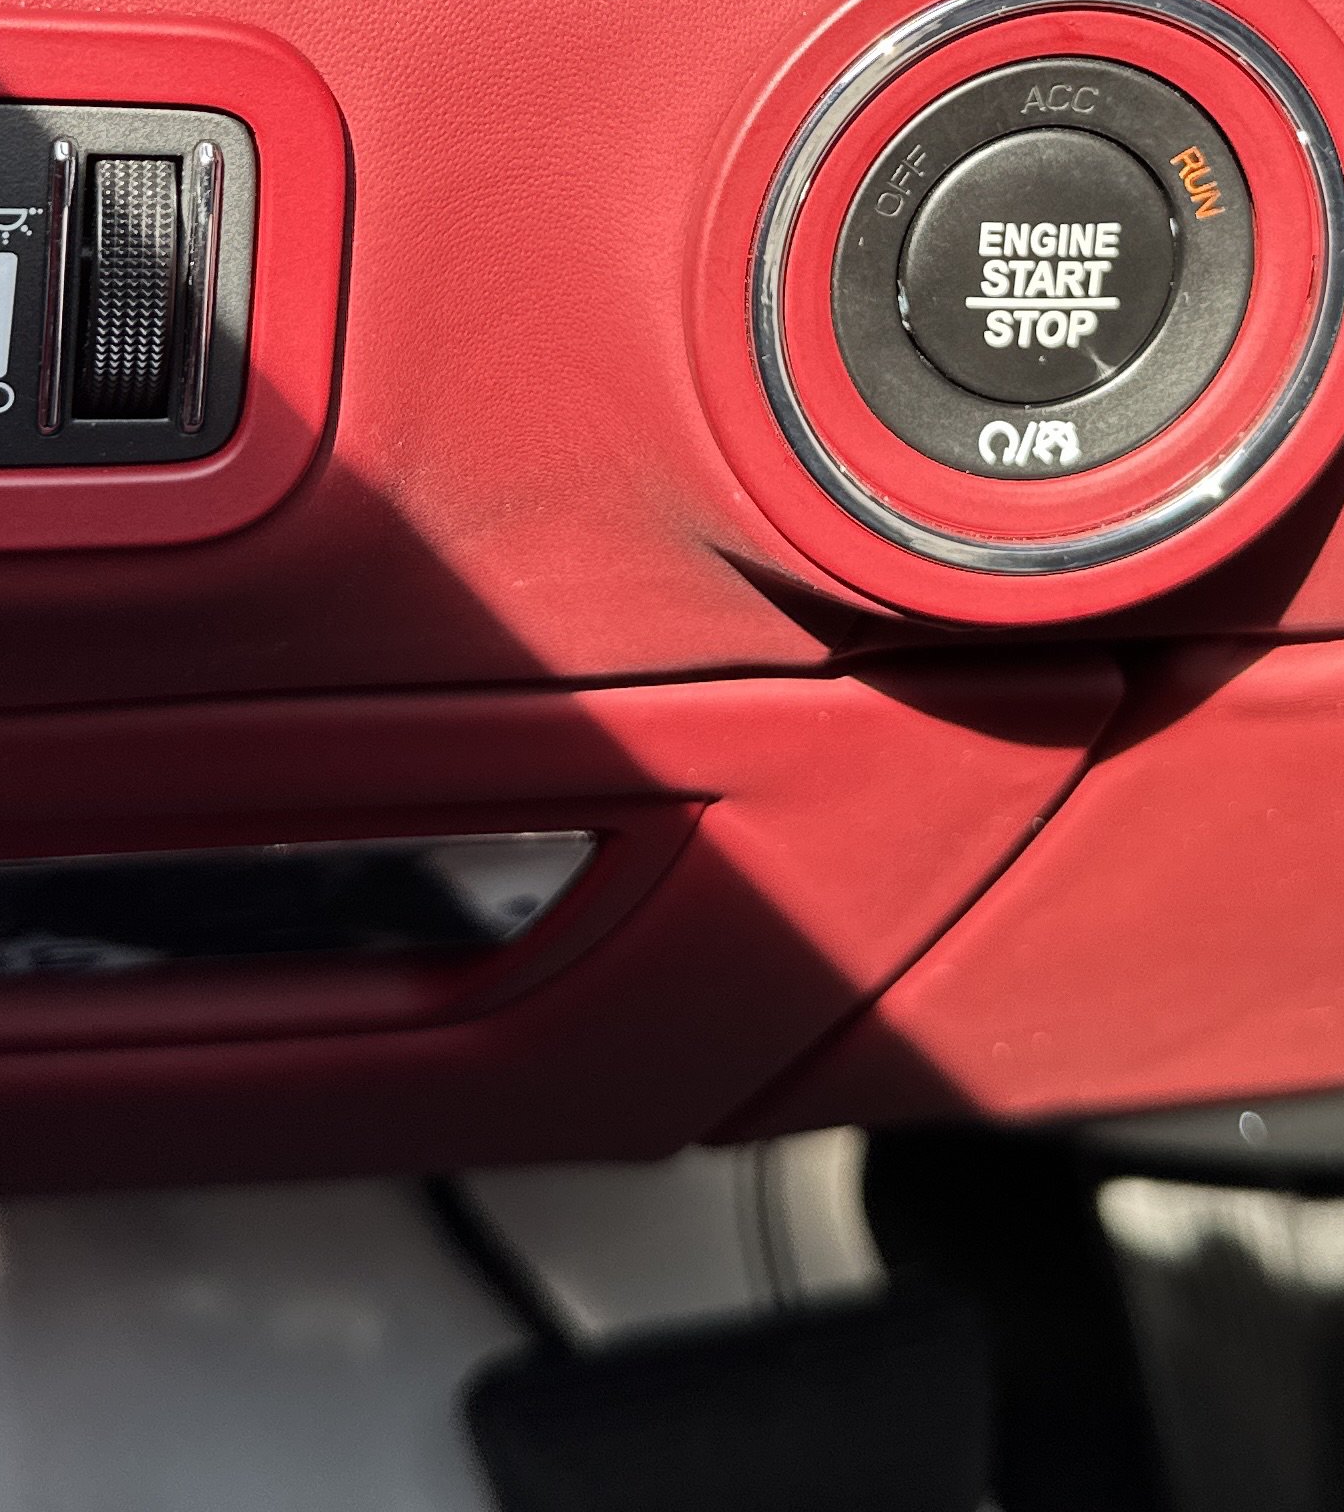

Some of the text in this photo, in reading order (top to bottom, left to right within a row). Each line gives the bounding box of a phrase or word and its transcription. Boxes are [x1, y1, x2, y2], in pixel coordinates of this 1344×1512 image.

[1019, 83, 1100, 115] ACC
[874, 143, 930, 219] OFF
[1168, 144, 1226, 221] RUN
[977, 221, 1122, 258] ENGINE
[979, 259, 1112, 299] START
[983, 309, 1098, 349] STOP
